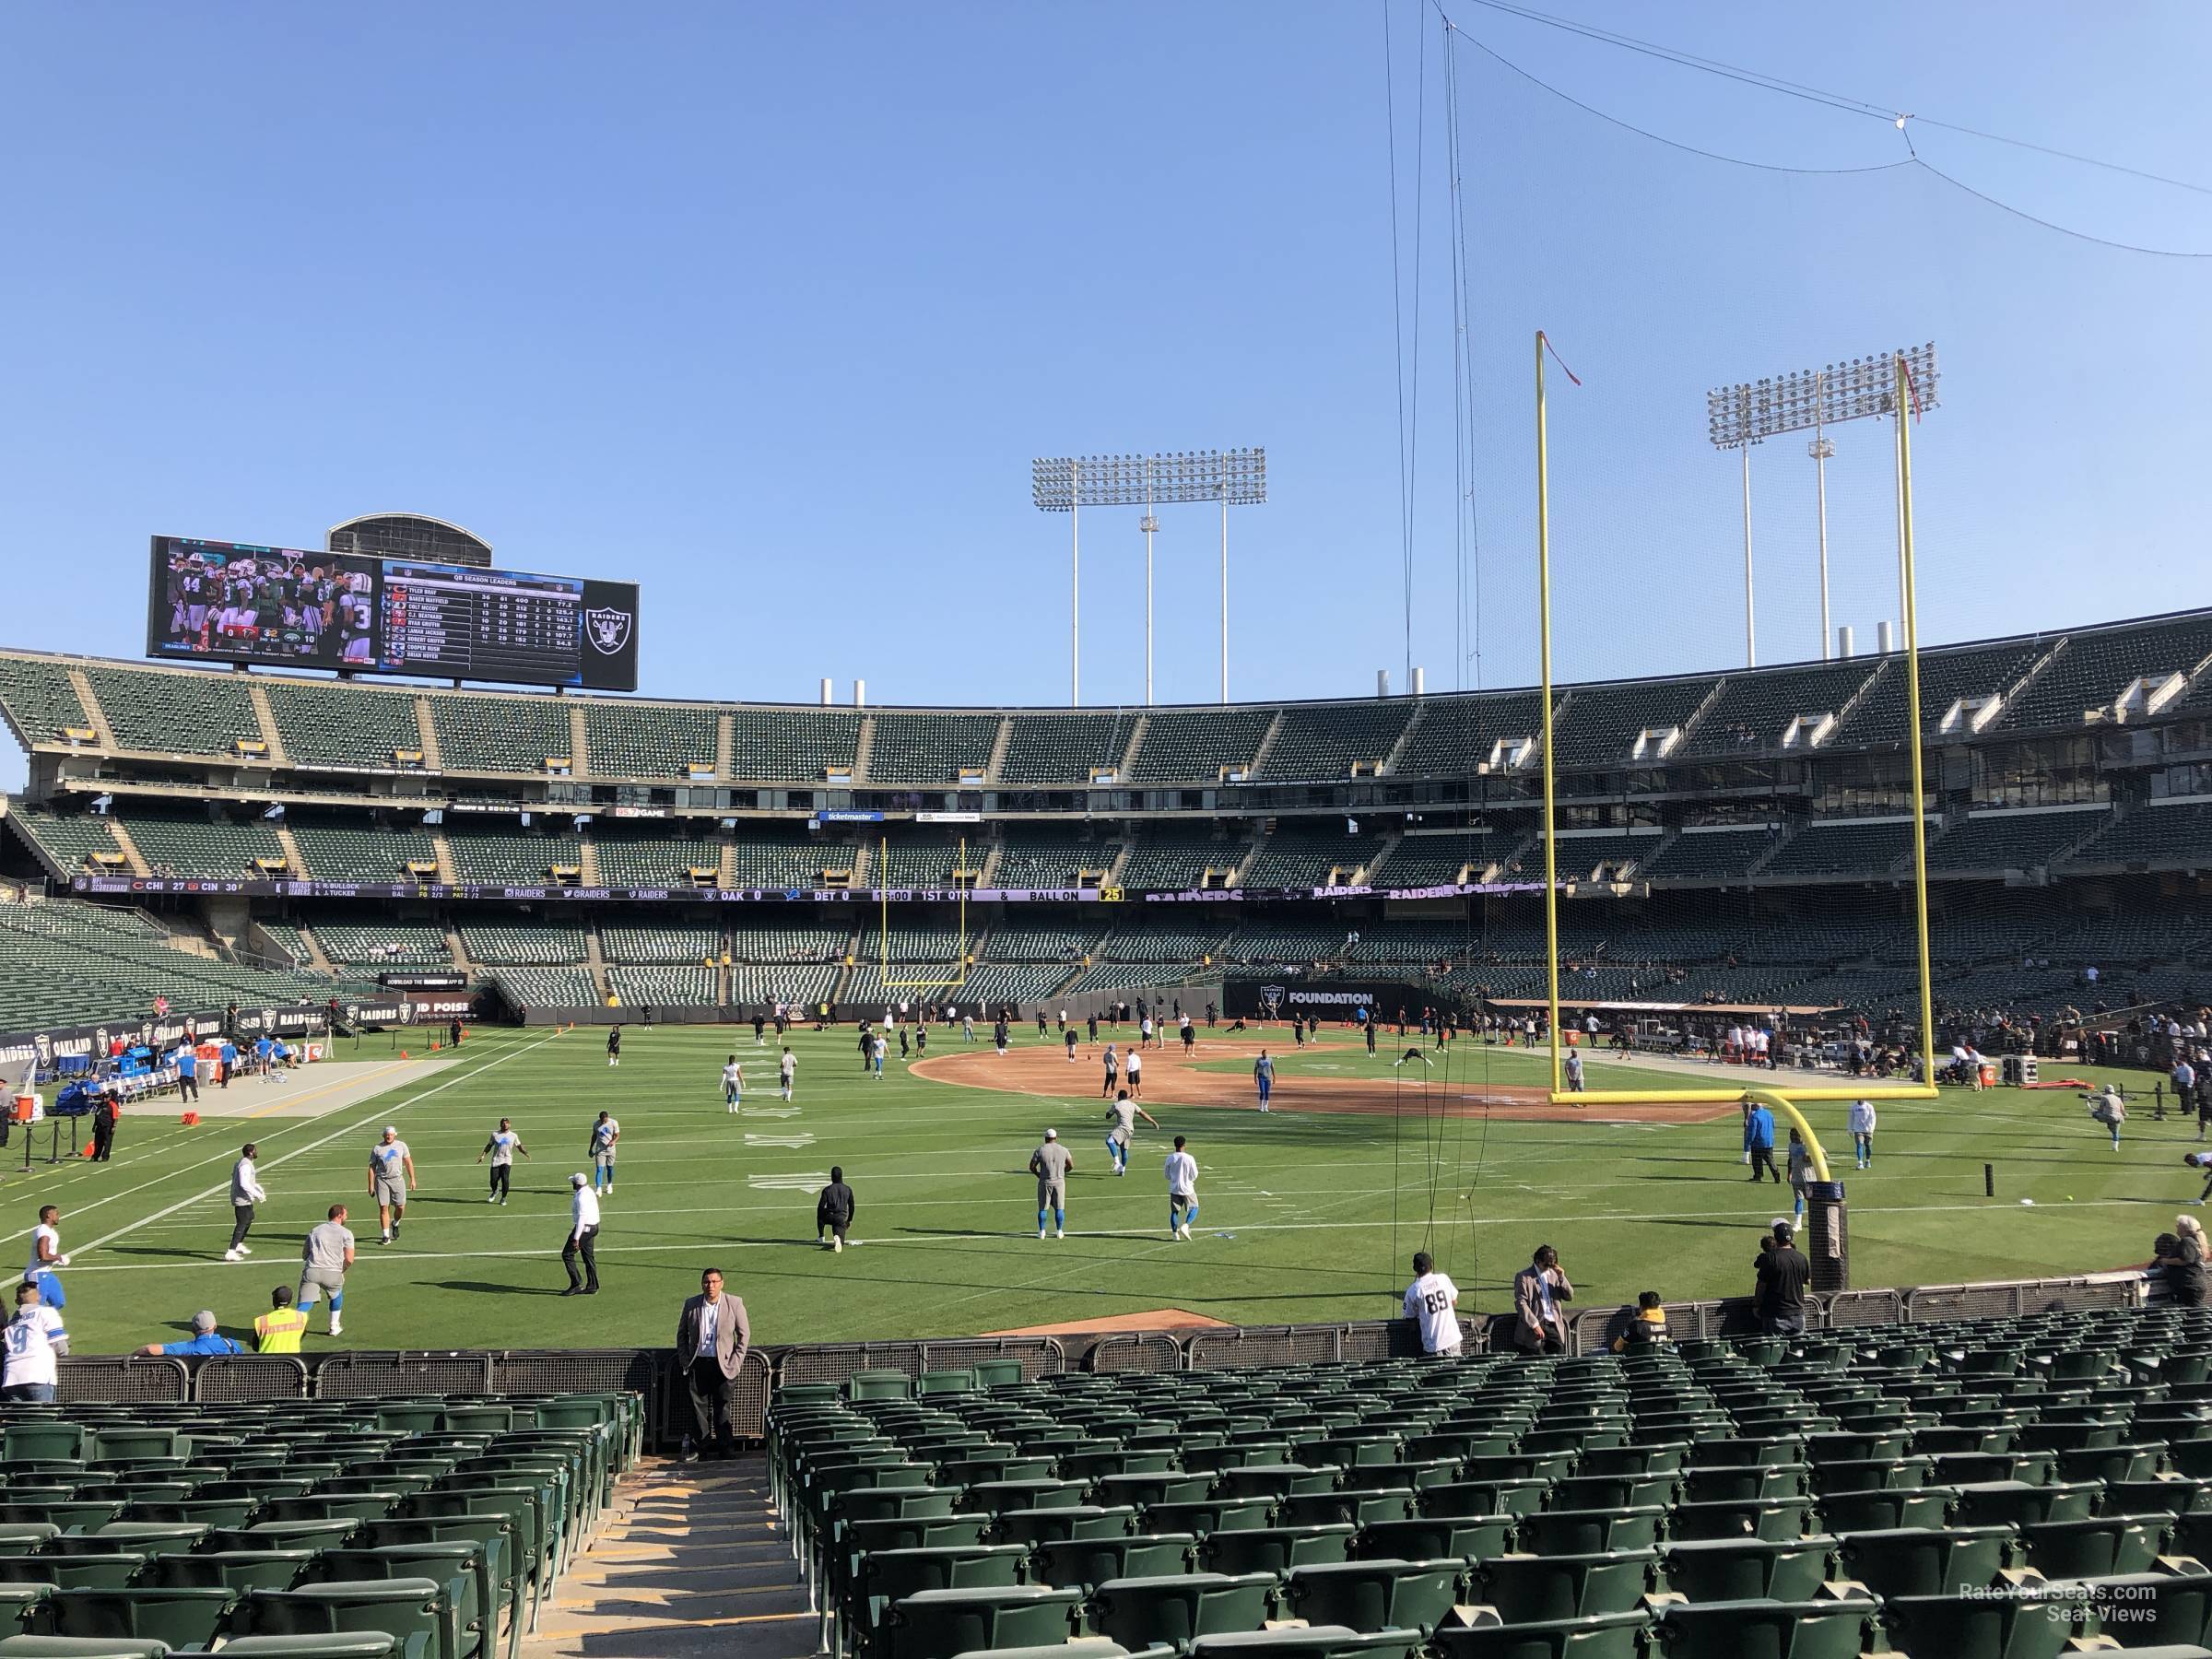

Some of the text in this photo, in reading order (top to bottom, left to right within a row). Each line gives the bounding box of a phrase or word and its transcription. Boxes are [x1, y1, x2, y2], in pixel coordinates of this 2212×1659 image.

[465, 575, 488, 583] SEASON
[592, 613, 625, 621] RAIDERS
[92, 884, 127, 892] SCOREBOARD
[146, 882, 163, 890] CHI
[172, 882, 184, 890] 27
[226, 883, 237, 891] 30
[1314, 886, 1371, 896] RAIDERS
[515, 889, 546, 898] RAIDERS
[573, 890, 610, 899] @RAIDERS
[638, 890, 668, 900] RAIDERS
[722, 892, 744, 900] OAK
[754, 890, 761, 900] 0
[815, 892, 836, 900] DET
[842, 891, 849, 900] 0
[922, 891, 942, 900] 1ST
[948, 890, 969, 900] QTR
[1001, 892, 1008, 900] &
[1030, 892, 1059, 900] BALL
[1063, 892, 1078, 900] ON
[1105, 891, 1119, 900] 25
[1289, 993, 1373, 1005] FOUNDATION
[434, 1003, 468, 1011] POISE
[360, 1009, 396, 1020] RAIDERS
[280, 1014, 322, 1026] RAIDERS
[53, 1038, 91, 1056] OAKLAND
[197, 1021, 219, 1034] RAIDERS
[1986, 1071, 1994, 1080] G
[1425, 1290, 1448, 1315] 89
[13, 1324, 28, 1354] 9
